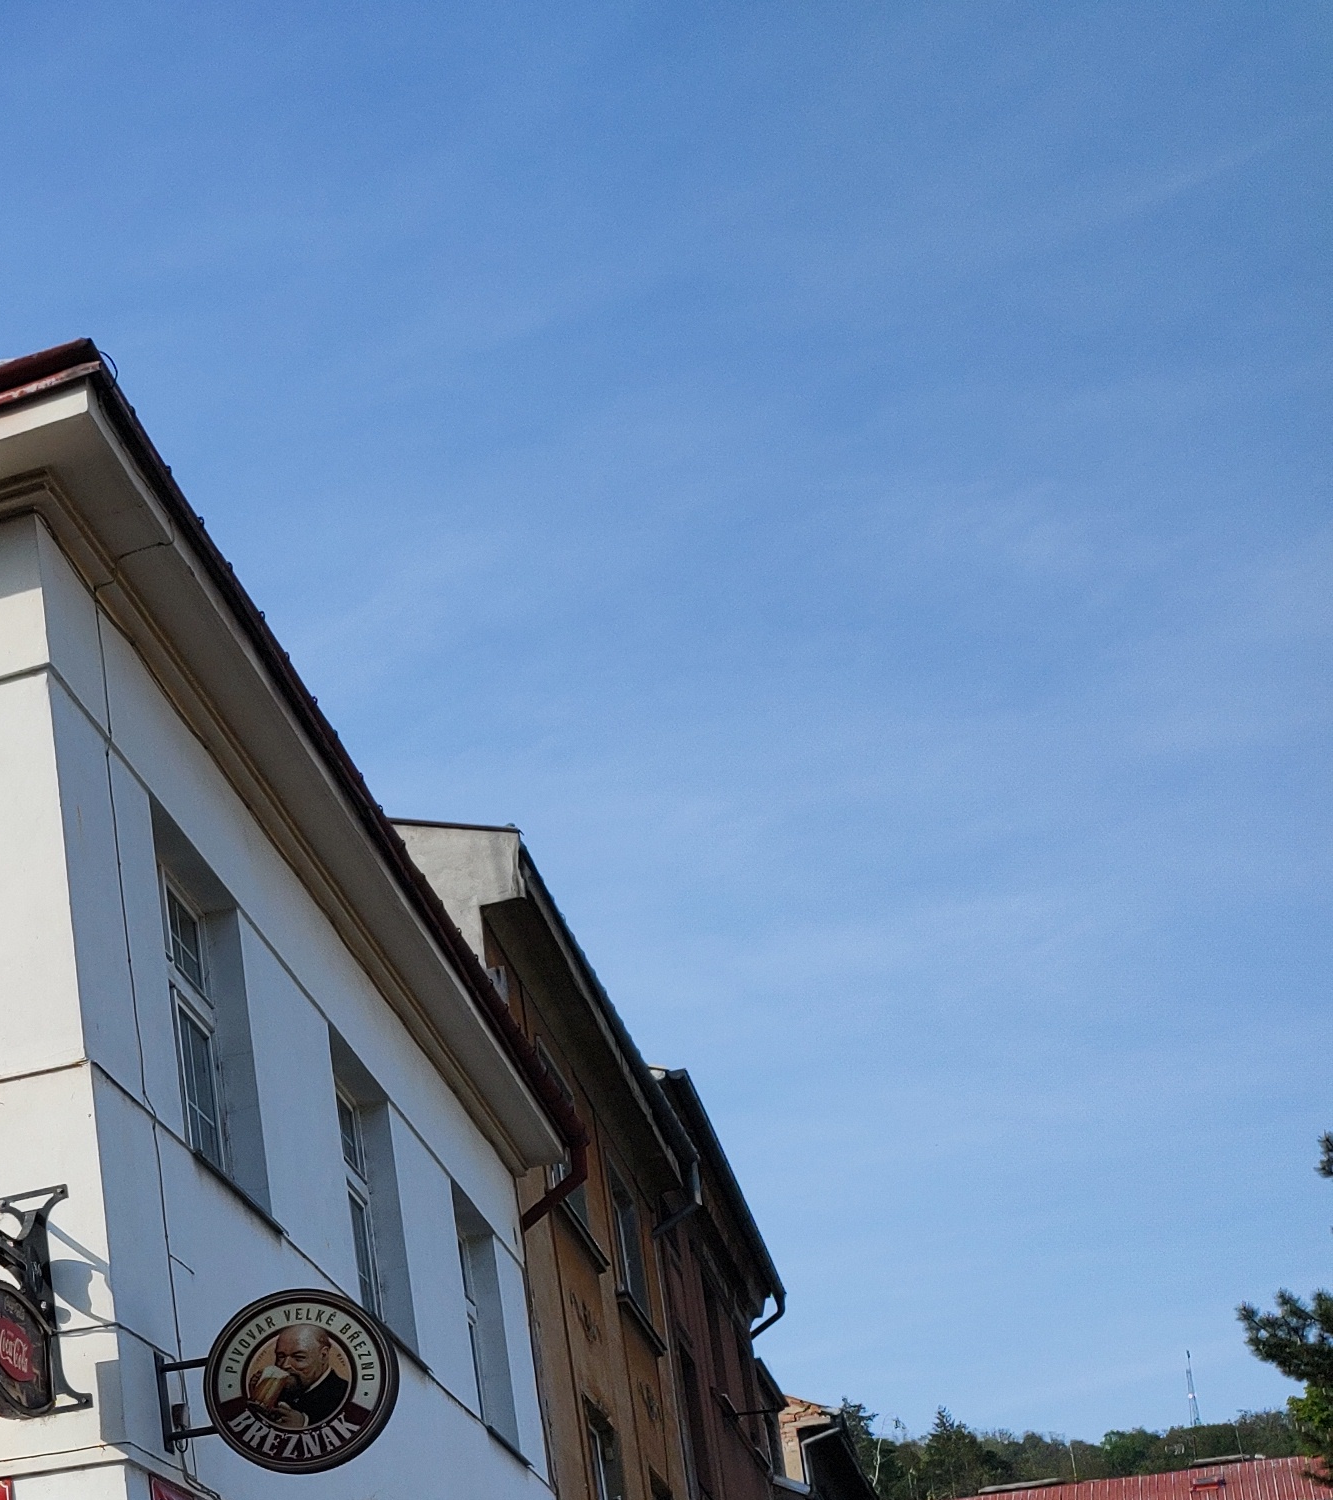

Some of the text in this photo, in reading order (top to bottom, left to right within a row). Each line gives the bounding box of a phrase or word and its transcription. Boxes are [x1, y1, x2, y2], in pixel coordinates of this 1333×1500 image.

[225, 1307, 375, 1382] PIVOVAR VELKÉ BŘEZNO
[228, 1411, 362, 1460] BŘEZŇÁK
